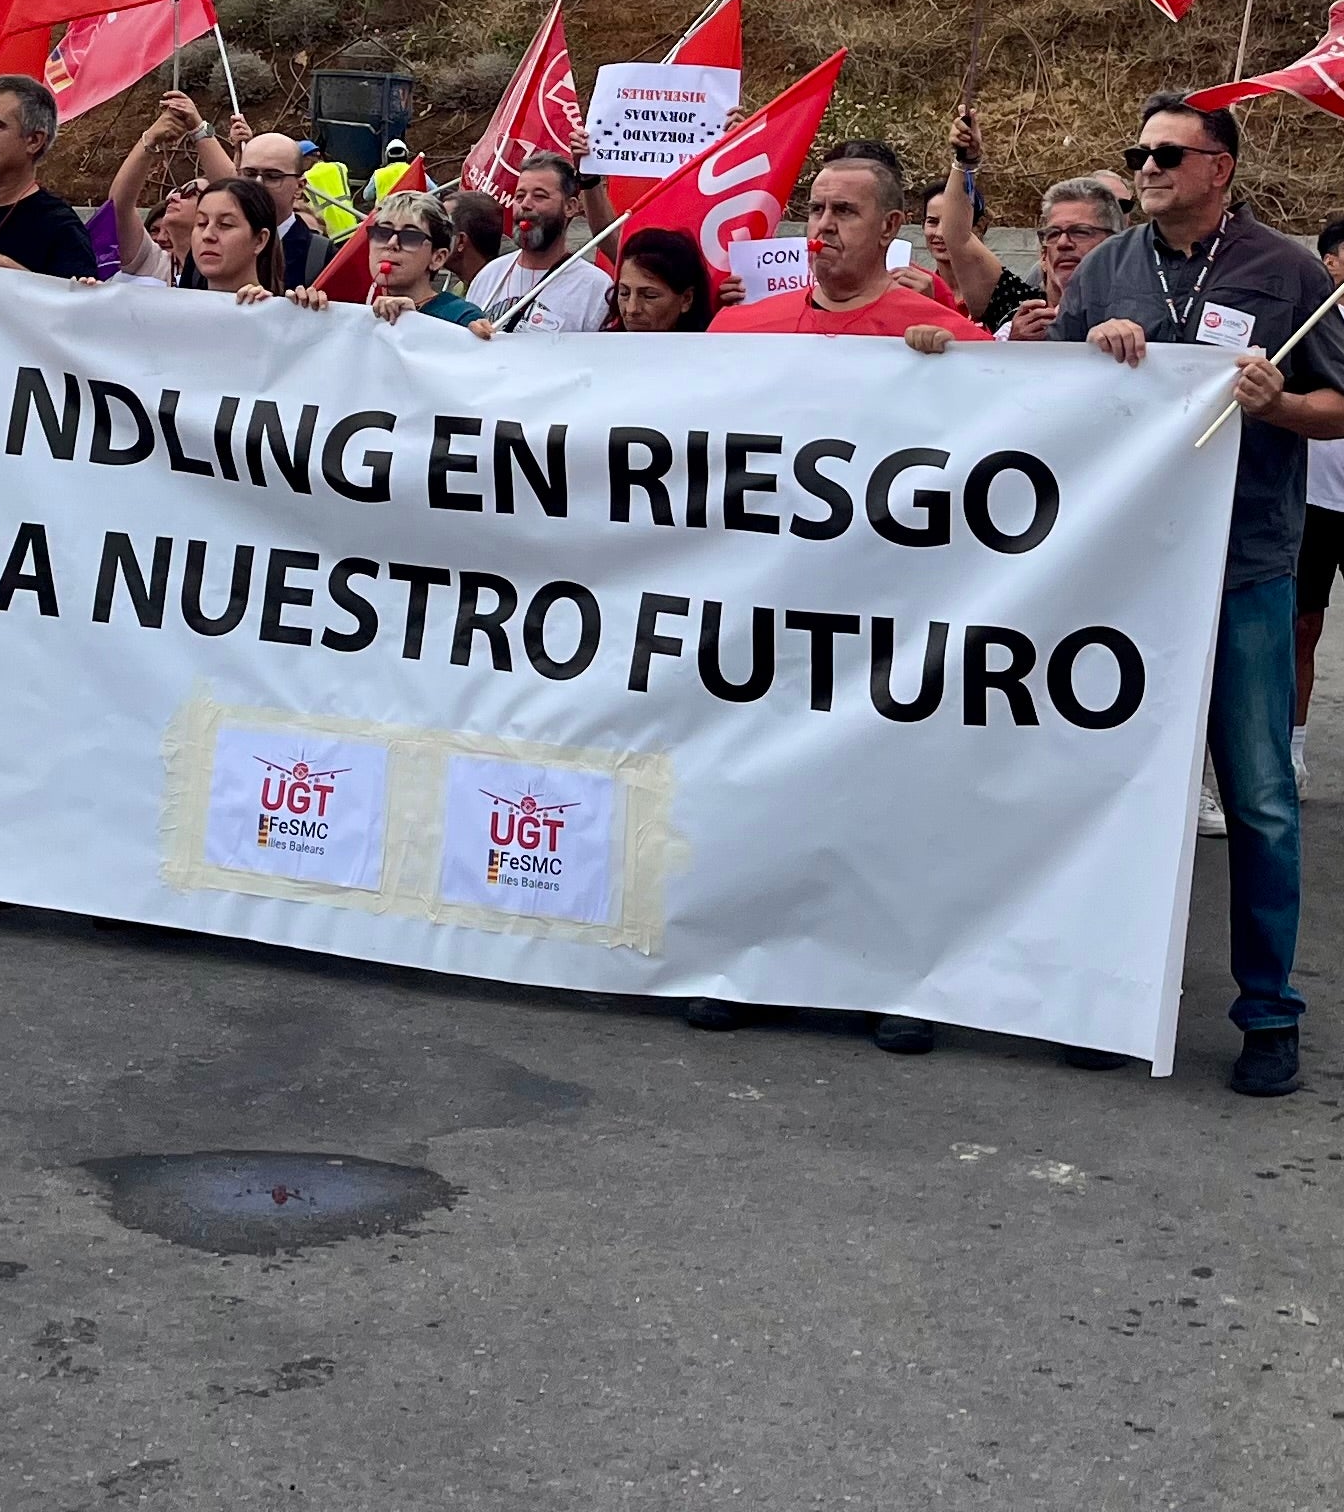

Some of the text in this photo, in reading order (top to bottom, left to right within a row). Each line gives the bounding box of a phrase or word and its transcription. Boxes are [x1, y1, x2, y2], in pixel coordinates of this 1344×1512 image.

[616, 88, 706, 103] MISERABLES!
[624, 109, 697, 123] JORNADAS
[623, 129, 695, 144] FORZANDO
[757, 249, 800, 268] ¡CON
[427, 415, 568, 518] EN
[608, 426, 1060, 555] RIESGO
[91, 531, 602, 681] NUESTRO
[627, 591, 1146, 730] FUTURO
[261, 778, 334, 817] UGT
[269, 816, 329, 839] FeSMC
[490, 811, 564, 852] UGT
[289, 840, 325, 855] Balears
[499, 851, 562, 875] FeSMC
[498, 874, 560, 891] Illes Balears
